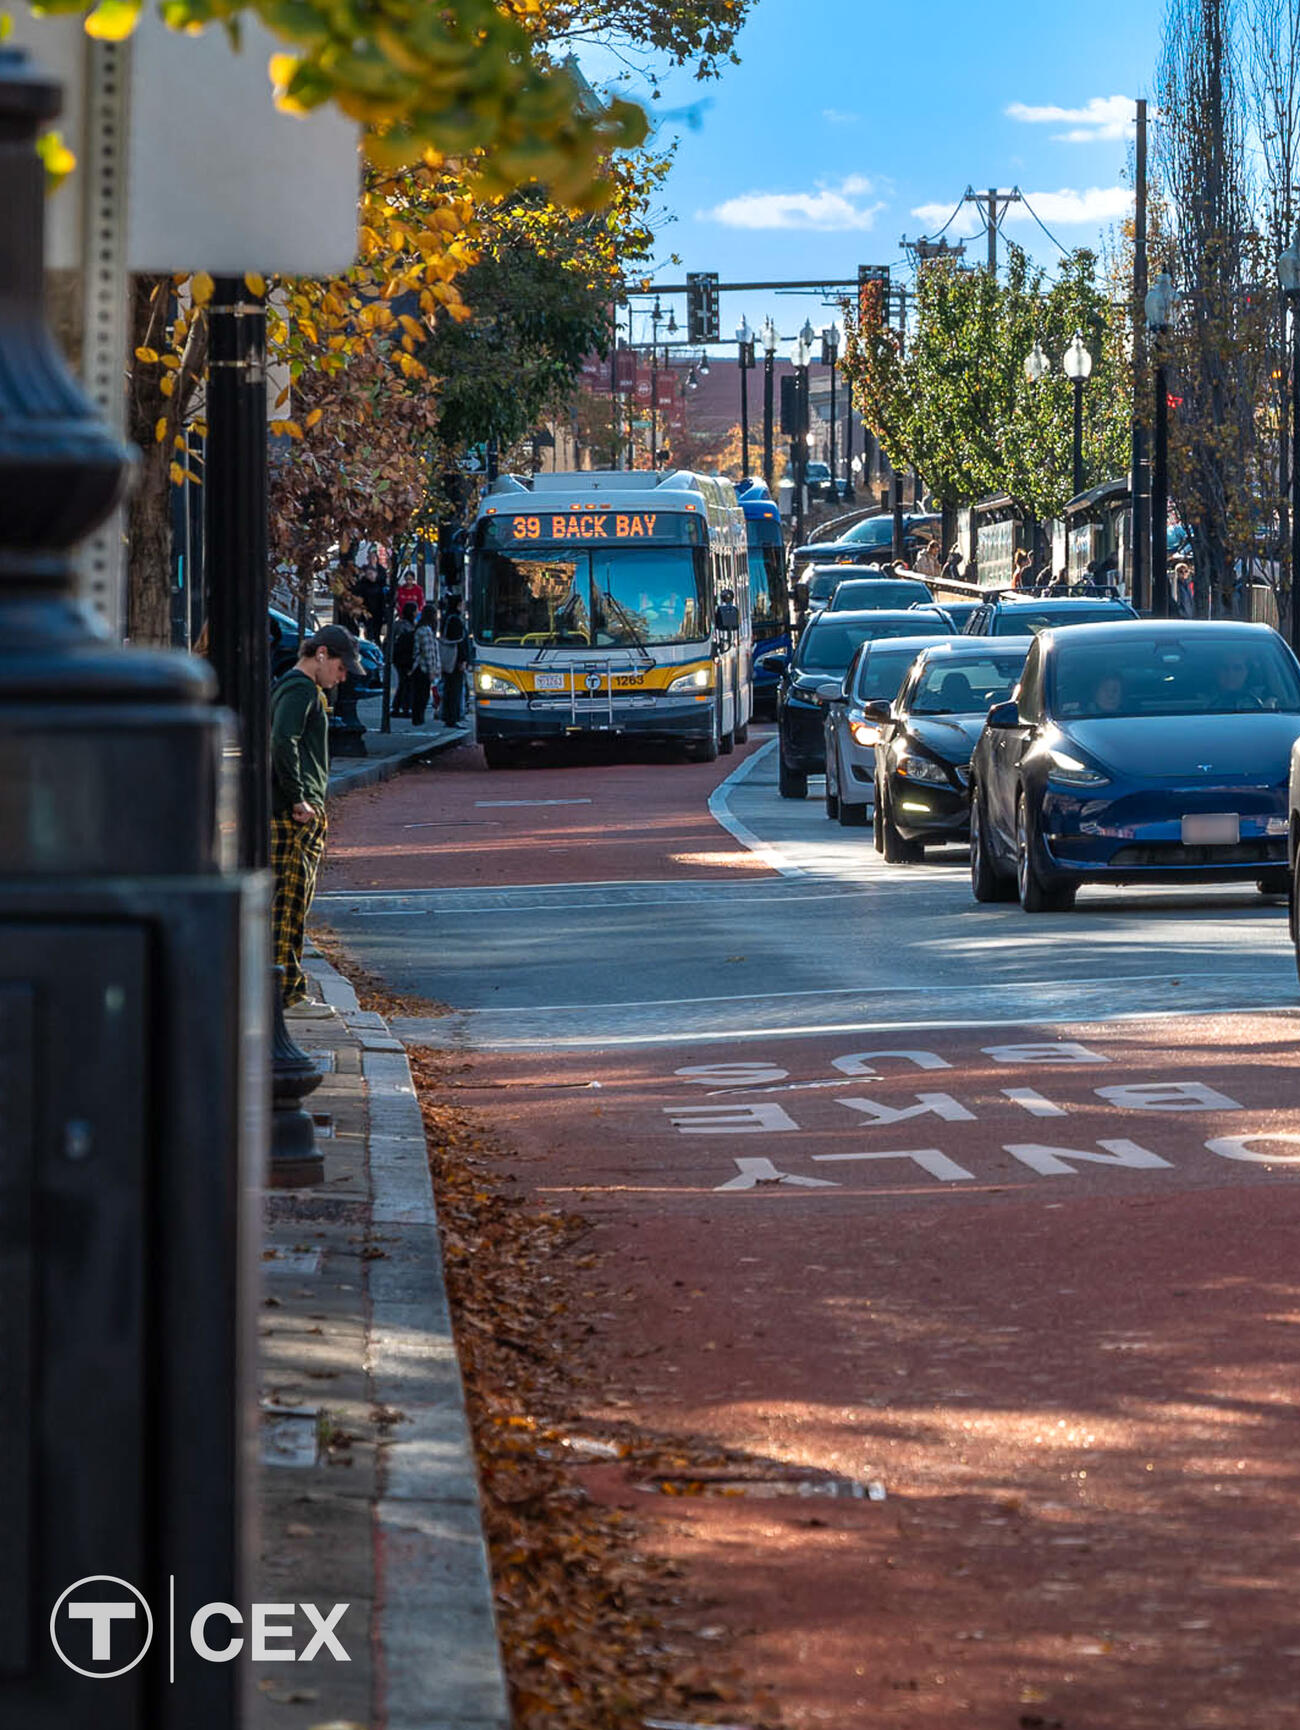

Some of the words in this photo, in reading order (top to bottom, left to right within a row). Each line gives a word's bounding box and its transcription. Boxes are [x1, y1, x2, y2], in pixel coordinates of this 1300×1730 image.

[513, 516, 541, 539] 39
[552, 515, 608, 538] BACK
[616, 514, 657, 537] BAY
[674, 1042, 1108, 1085] BUS
[662, 1082, 1245, 1134] BIKE
